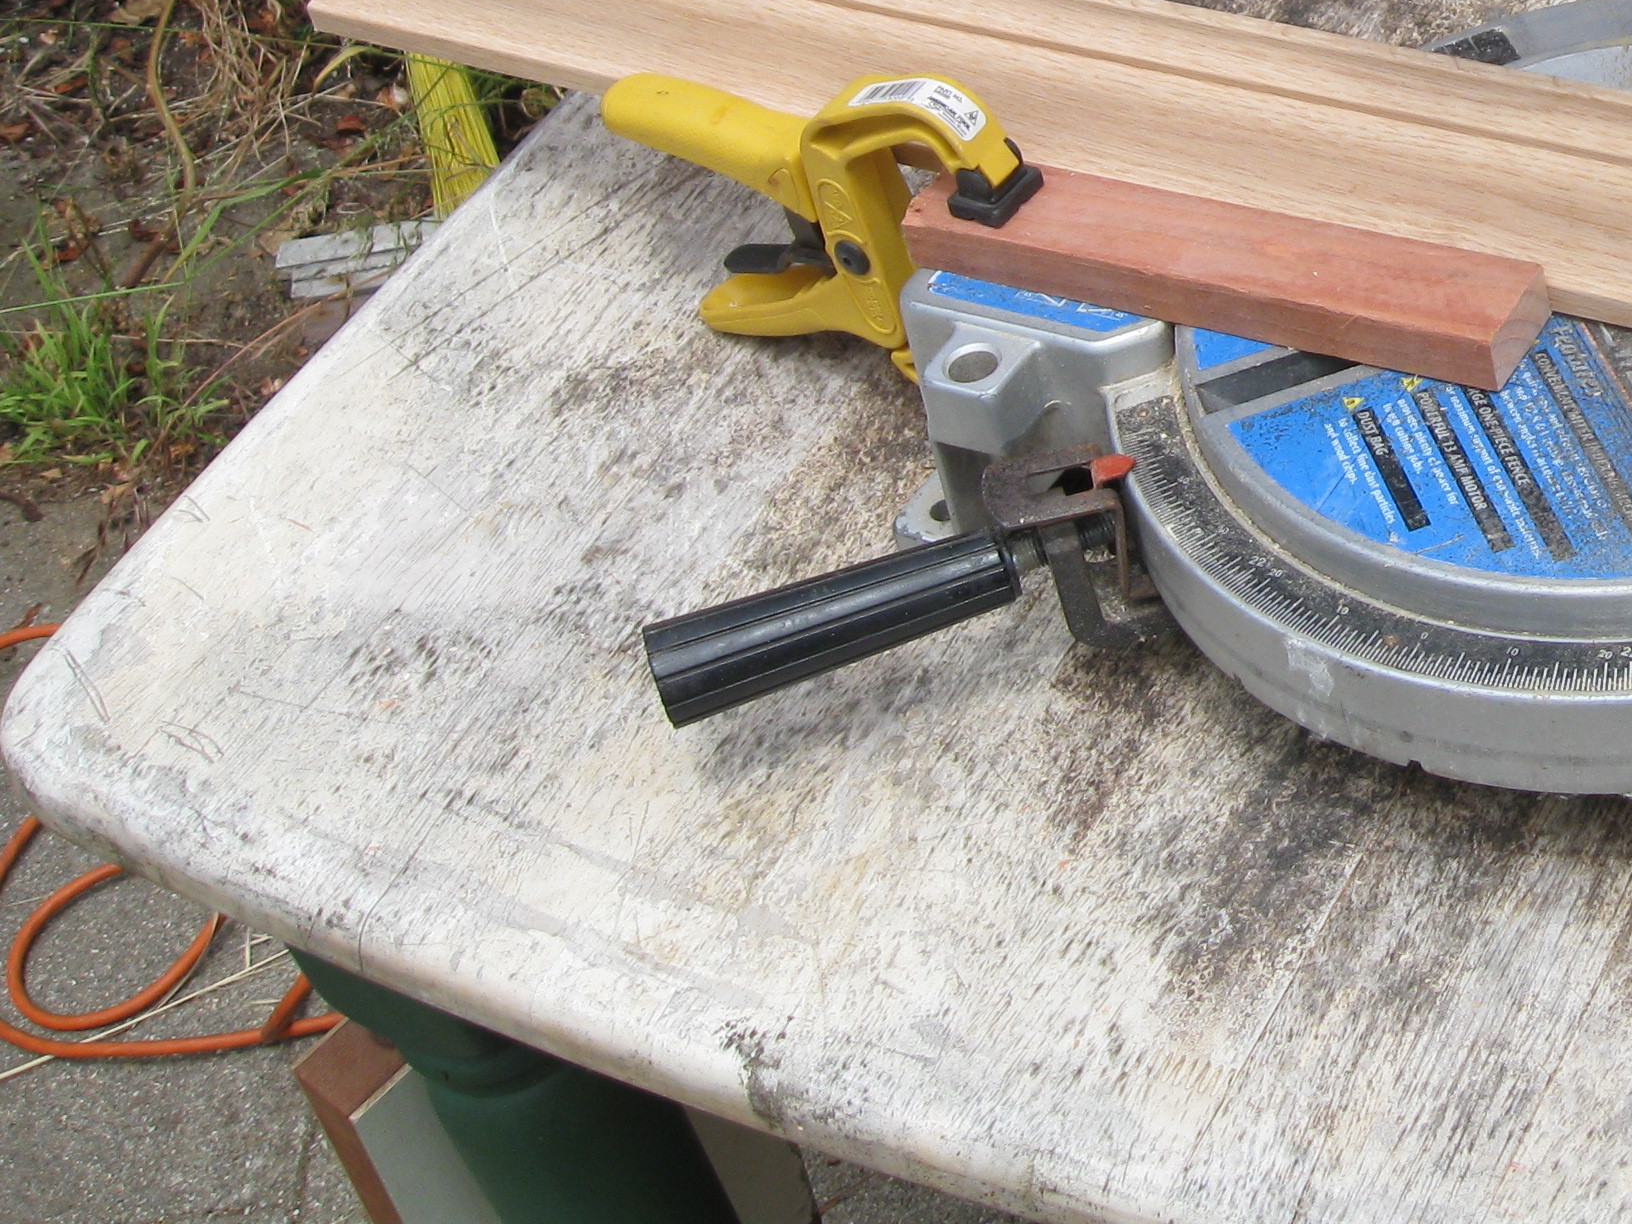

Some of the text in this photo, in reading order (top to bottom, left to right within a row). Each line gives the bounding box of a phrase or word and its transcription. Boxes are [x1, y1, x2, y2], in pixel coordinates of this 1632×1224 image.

[1549, 324, 1604, 398] Features
[1321, 421, 1339, 439] and
[1356, 411, 1389, 457] DUST BAG
[1448, 395, 1476, 434] maximum
[1329, 438, 1350, 461] wood
[1393, 426, 1416, 453] cutting
[1415, 390, 1450, 440] POWERFUL
[1441, 439, 1457, 453] 13
[1459, 475, 1488, 511] MOTOR
[1466, 386, 1530, 486] RGE ONE-PIECE FENCE
[1337, 417, 1398, 523] to collect fine dust particles
[1412, 430, 1435, 456] plenty
[1445, 490, 1462, 506] for
[1336, 603, 1350, 616] 10
[1505, 646, 1520, 656] 10
[1598, 649, 1613, 660] 20
